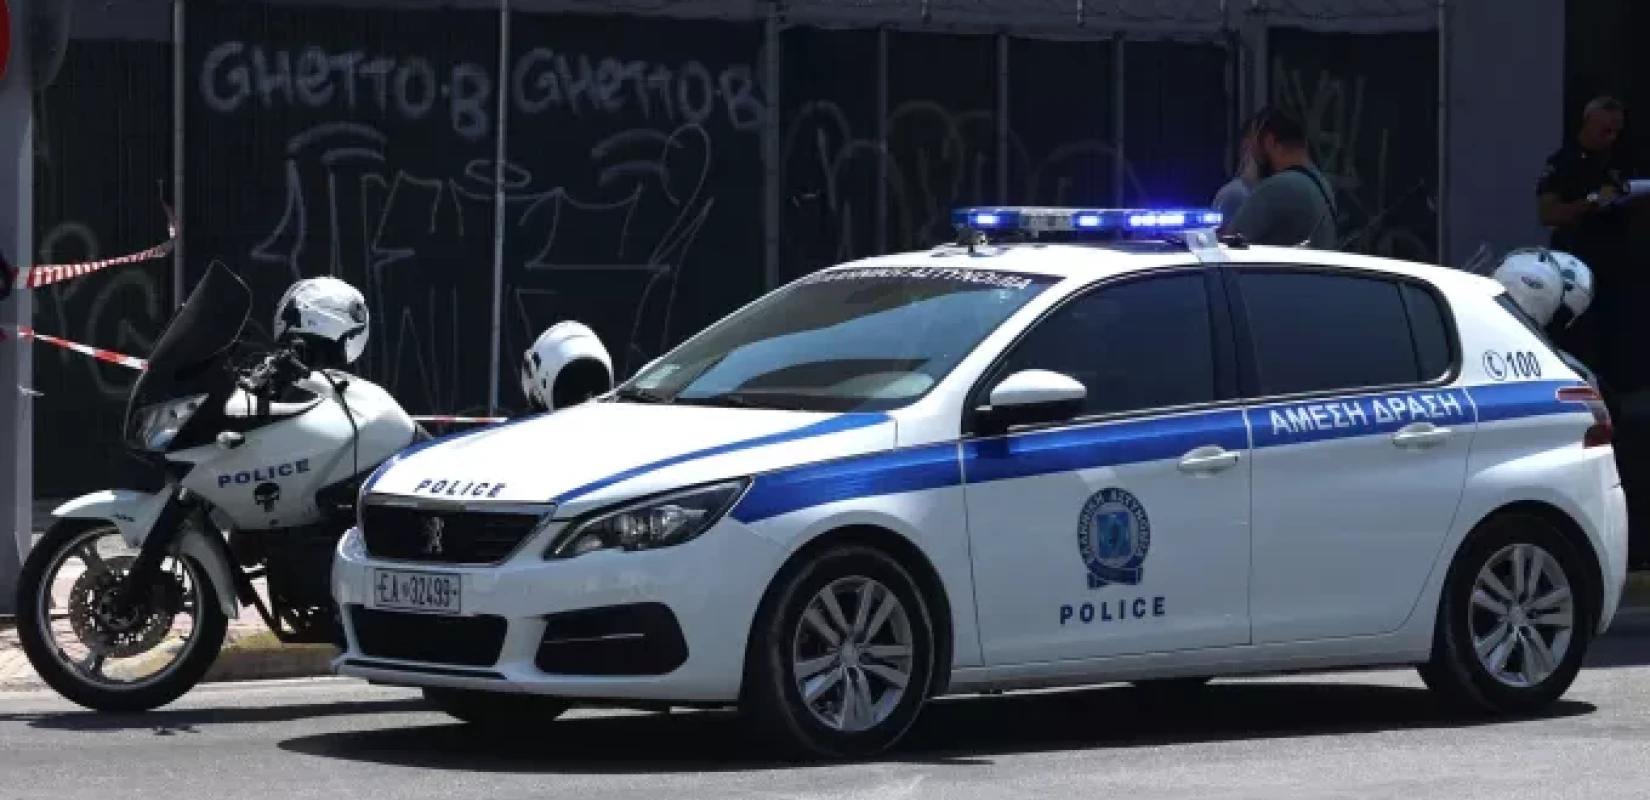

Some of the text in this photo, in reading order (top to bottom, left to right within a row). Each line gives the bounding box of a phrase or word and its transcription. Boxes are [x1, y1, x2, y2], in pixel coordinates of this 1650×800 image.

[1507, 351, 1541, 378] 100
[1269, 392, 1463, 434] ΑΜΕΣΗ ΔΡΑΣΗ
[217, 458, 311, 488] POLICE
[412, 479, 508, 498] POLICE
[1059, 596, 1166, 625] POLICE
